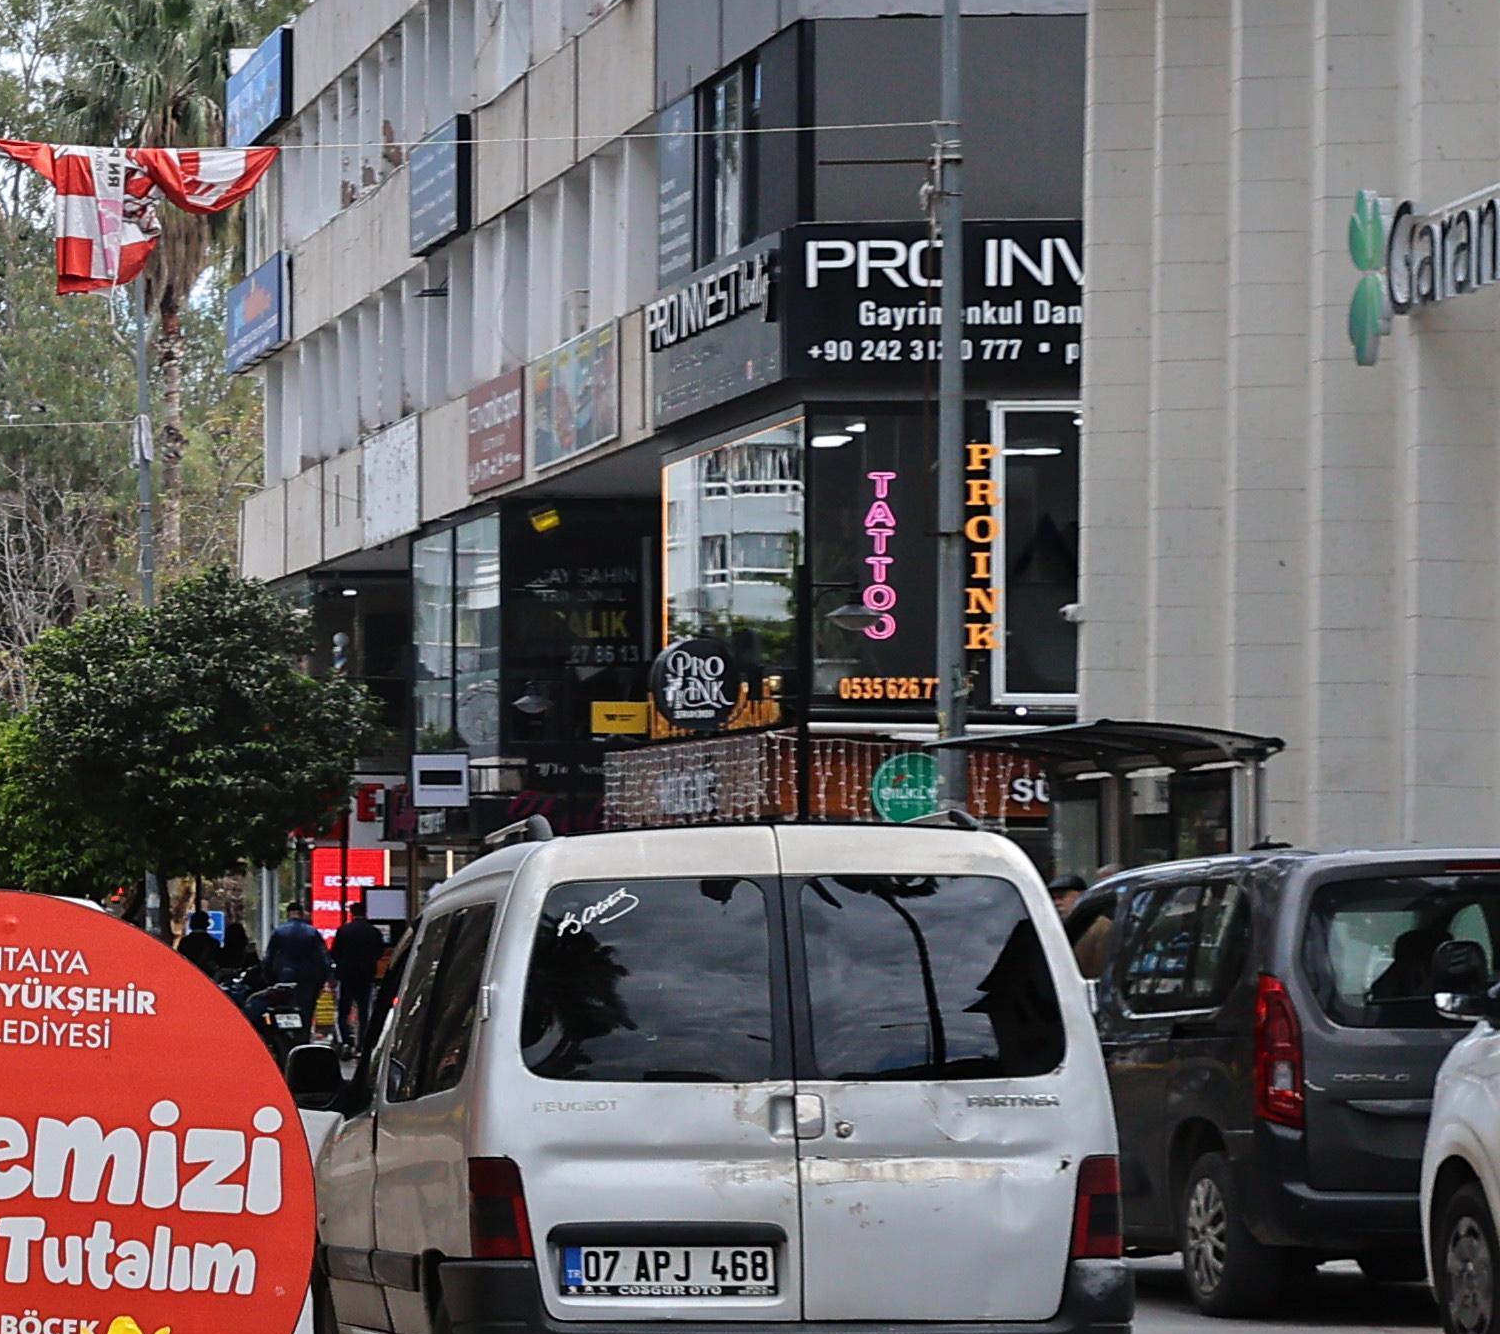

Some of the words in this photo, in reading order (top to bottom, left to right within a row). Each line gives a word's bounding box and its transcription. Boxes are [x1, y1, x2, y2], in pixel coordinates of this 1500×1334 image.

[807, 339, 854, 362] +90
[861, 339, 903, 362] 242
[981, 339, 1023, 360] 777
[864, 471, 899, 641] TATTOO
[965, 443, 1000, 651] PROINK
[667, 650, 725, 681] PRO
[531, 1099, 618, 1113] PEUGEOT
[966, 1094, 1060, 1108] PARTNER
[583, 1250, 620, 1283] 07
[634, 1250, 691, 1283] APJ
[711, 1250, 769, 1283] 468
[688, 1285, 722, 1296] OTO
